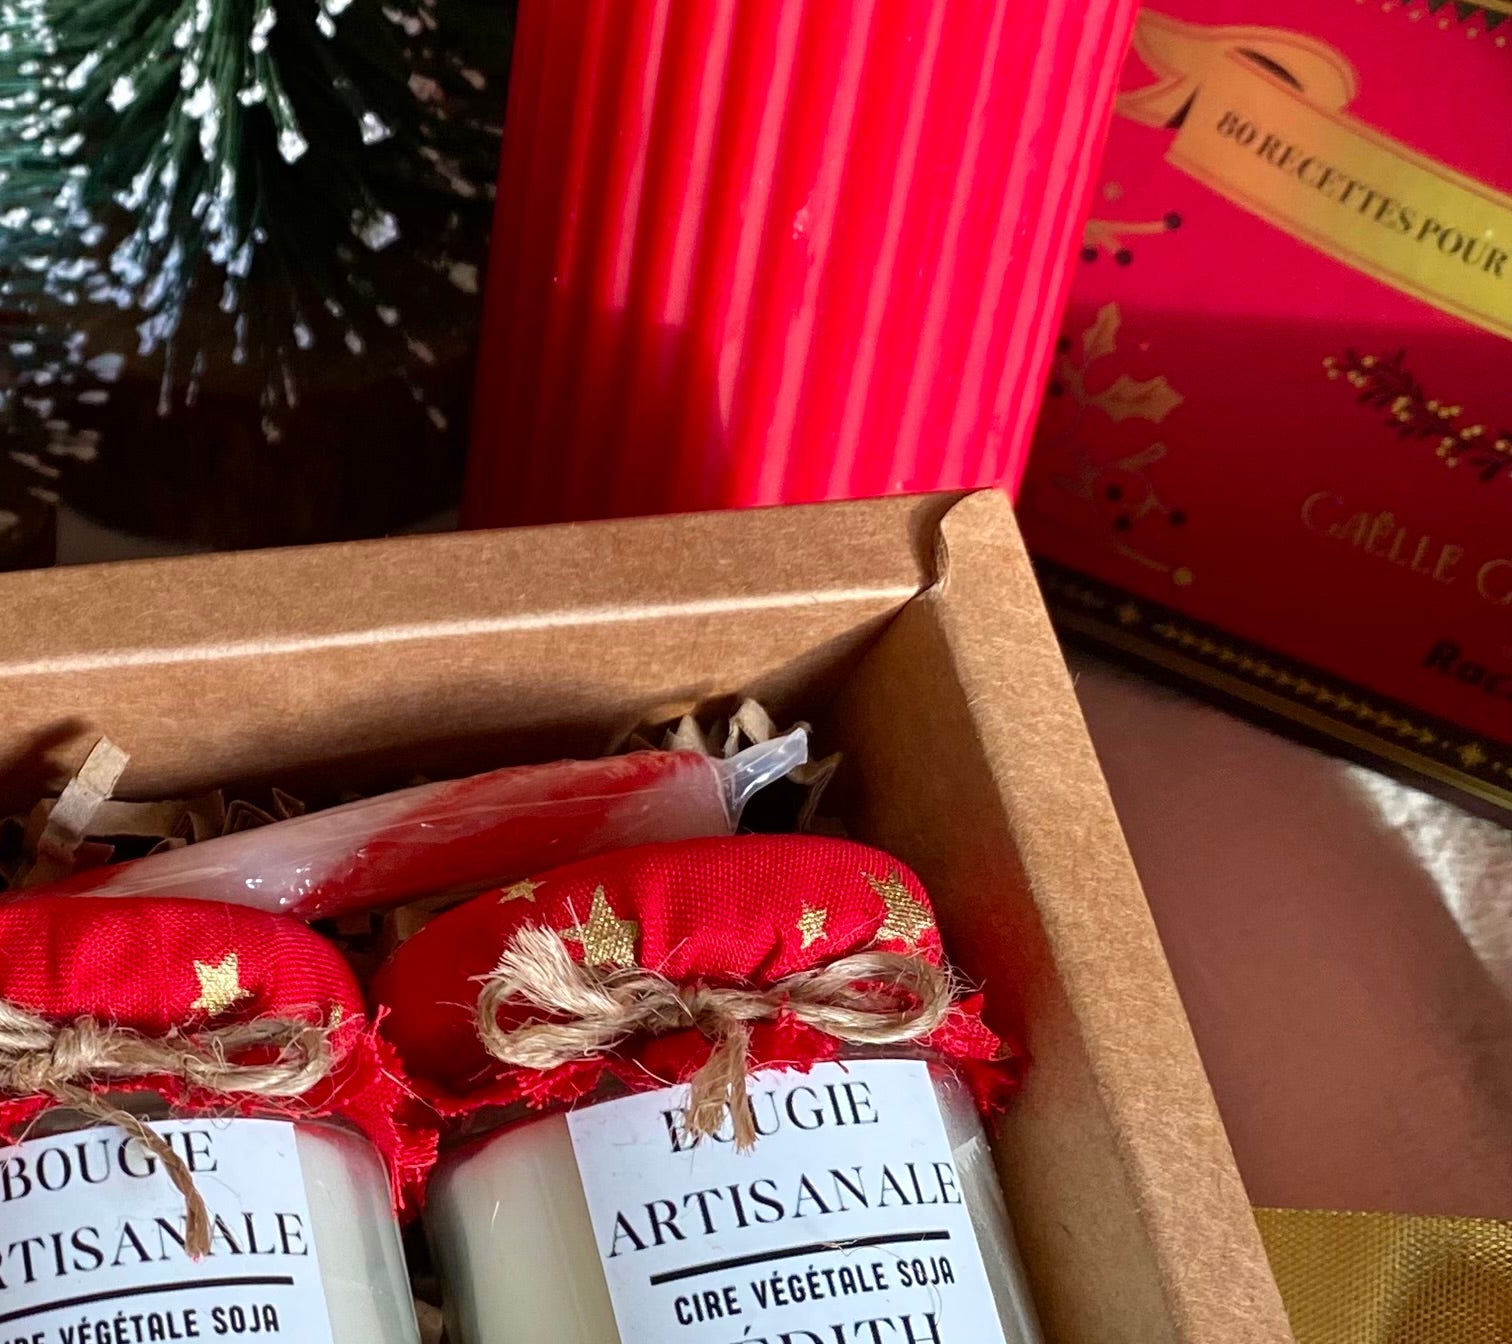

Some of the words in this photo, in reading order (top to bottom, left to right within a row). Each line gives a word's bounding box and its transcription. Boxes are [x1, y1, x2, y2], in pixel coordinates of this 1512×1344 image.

[1216, 111, 1257, 146] 80
[1256, 134, 1417, 234] RECETTES
[1416, 217, 1509, 279] POUR
[607, 1161, 962, 1258] ARTISANALE
[212, 1303, 280, 1335] SOJA
[674, 1286, 742, 1327] CIRE
[751, 1264, 889, 1310] VÉGÉTALE
[899, 1255, 956, 1287] SOJA
